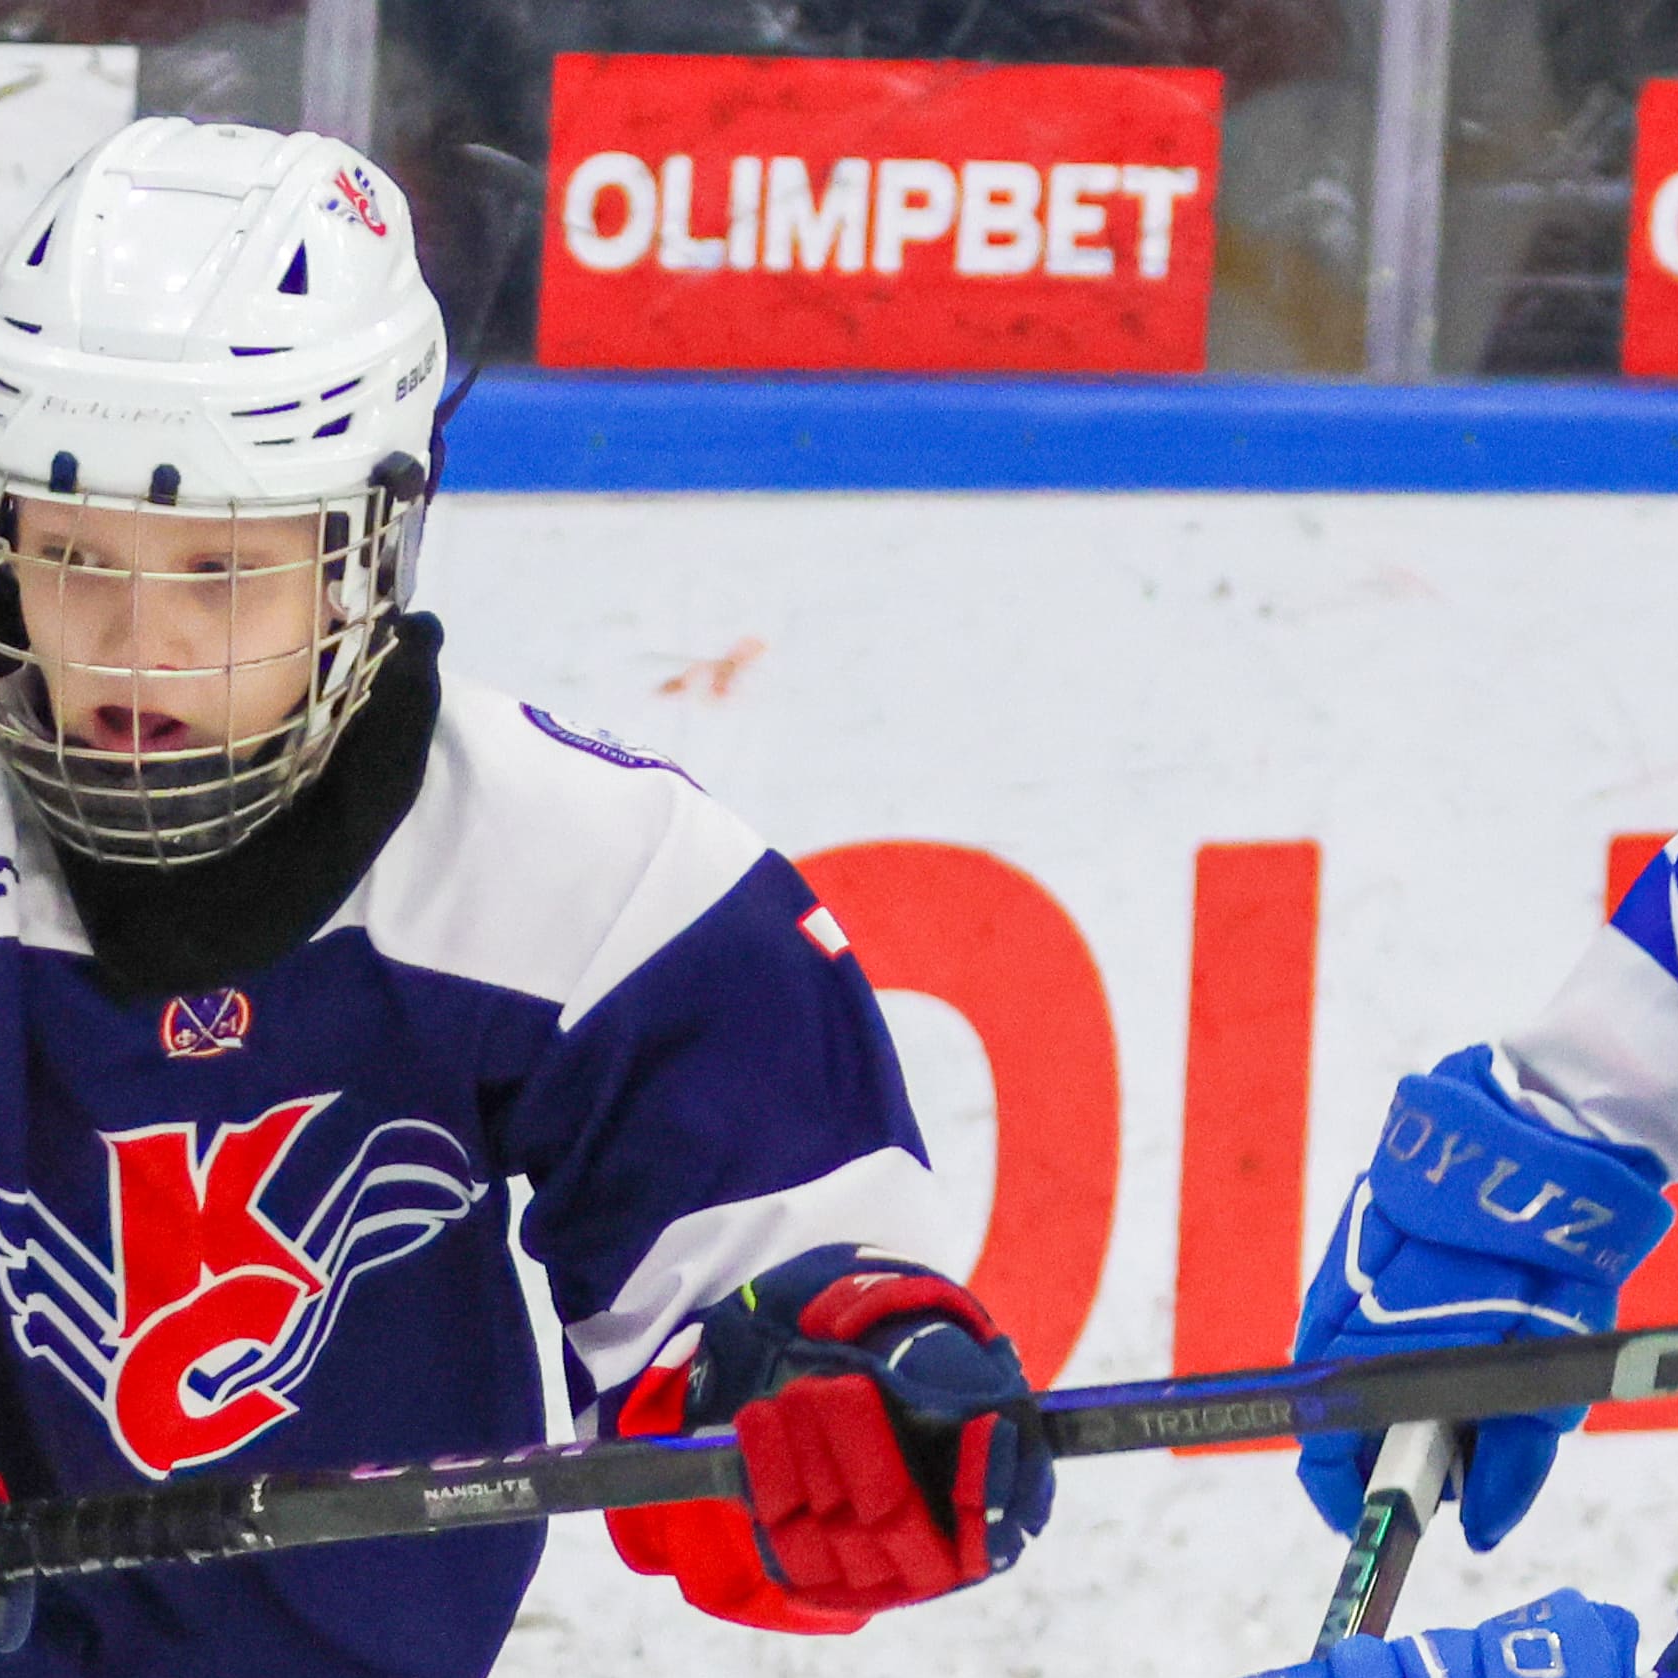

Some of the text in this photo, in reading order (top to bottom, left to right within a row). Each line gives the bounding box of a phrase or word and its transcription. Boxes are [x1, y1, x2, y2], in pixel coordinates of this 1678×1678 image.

[561, 150, 1201, 279] OLIMPBET
[1386, 1096, 1614, 1254] OYUZ
[1137, 1400, 1292, 1440] TRIGGER
[423, 1476, 531, 1501] NANOLITE
